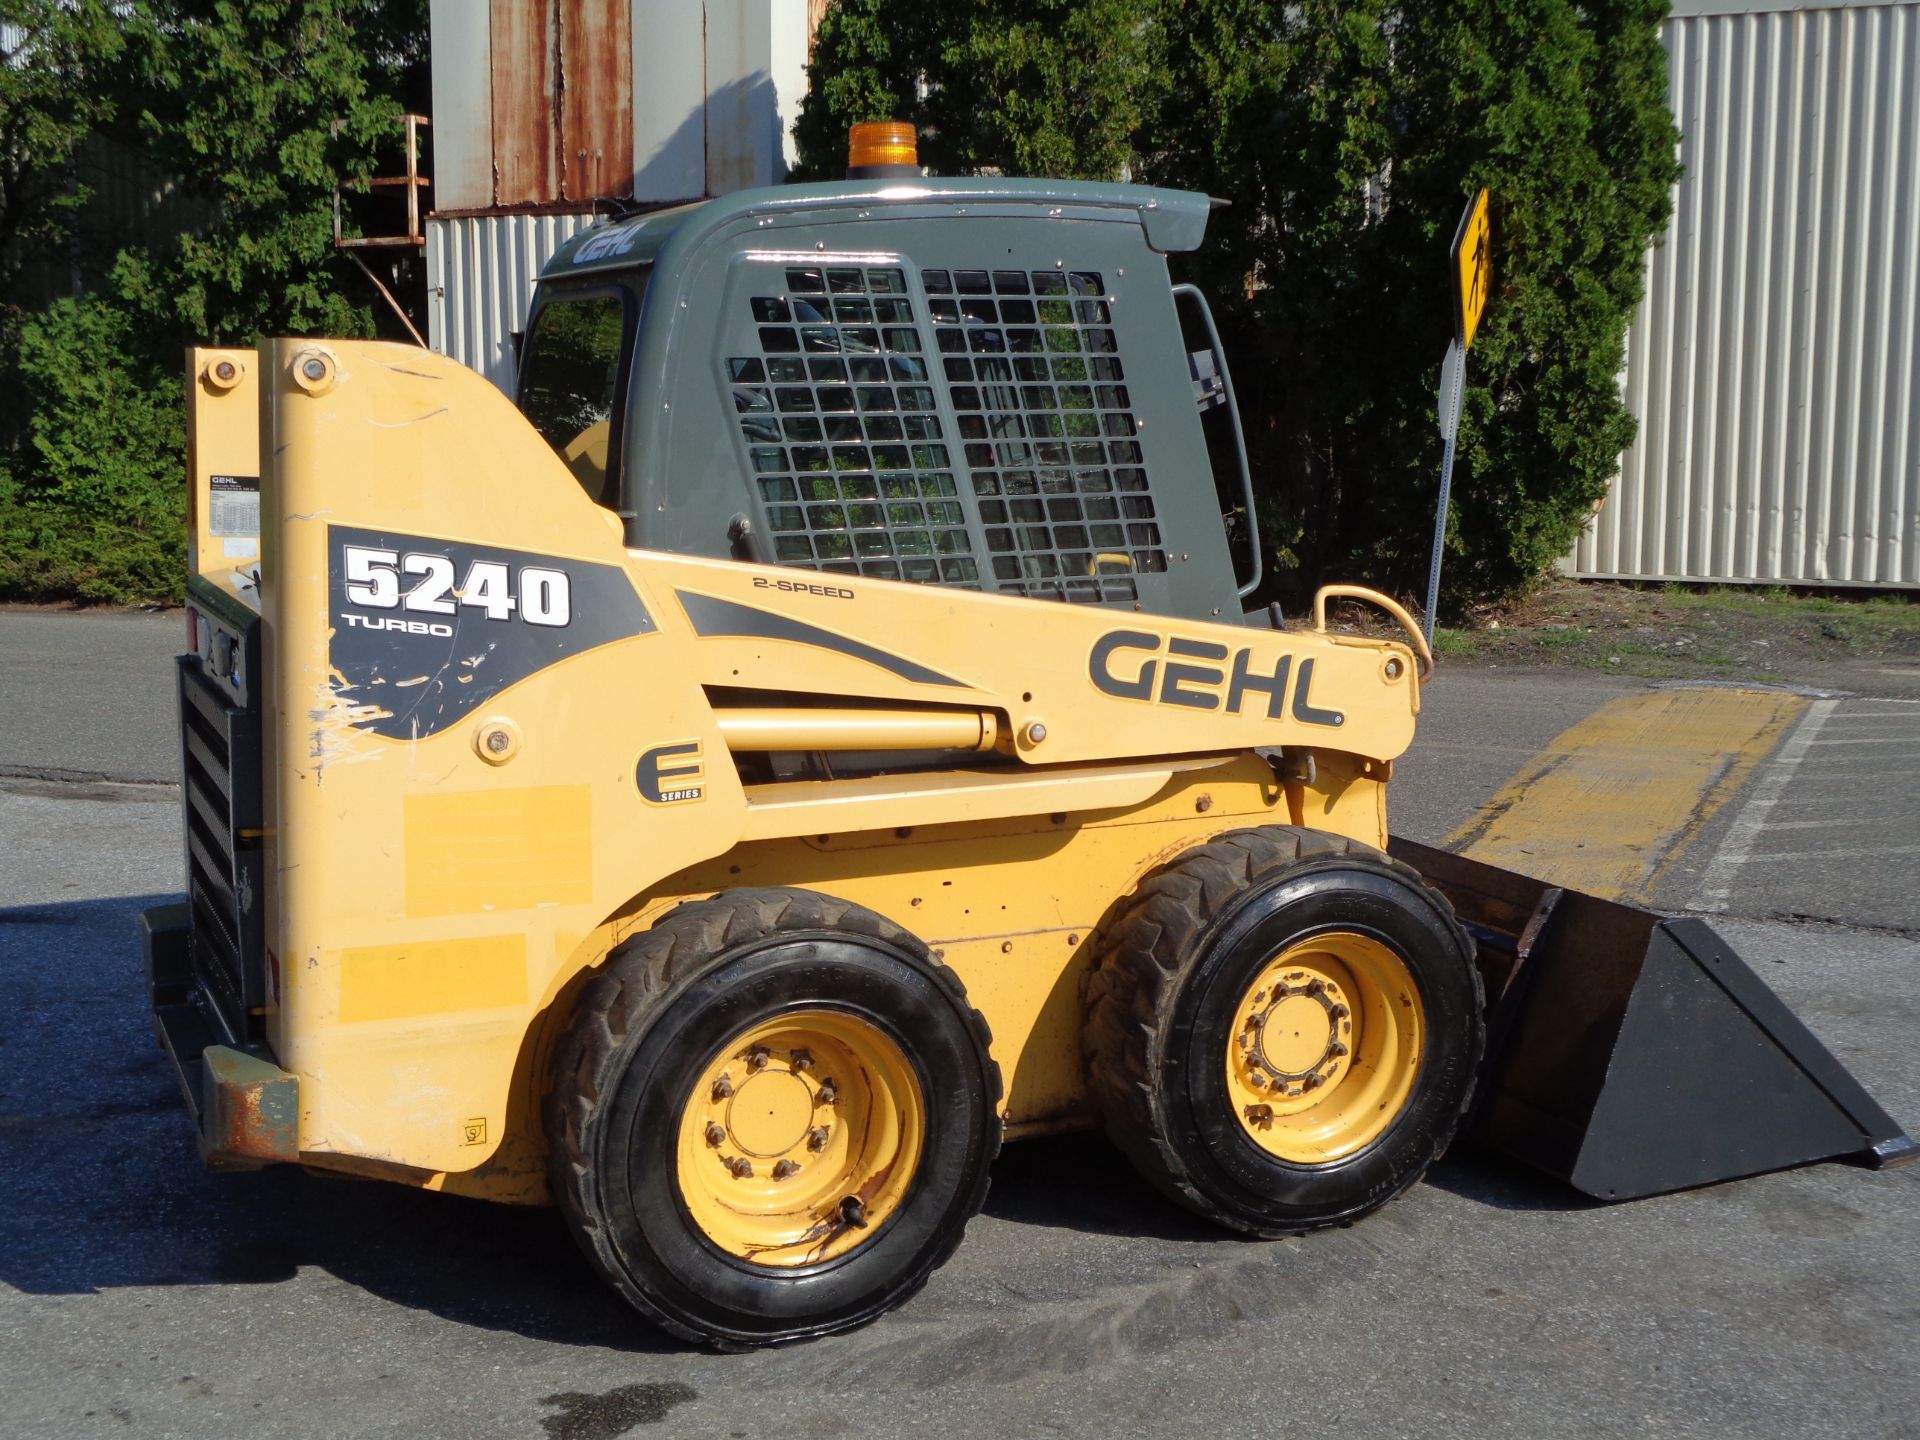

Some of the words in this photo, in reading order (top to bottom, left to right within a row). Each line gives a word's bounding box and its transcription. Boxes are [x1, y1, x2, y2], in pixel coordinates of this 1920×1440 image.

[211, 476, 238, 484] GEHL
[344, 545, 572, 629] 5240
[752, 577, 855, 600] 2-SPEED
[340, 613, 454, 638] TURBO
[1088, 629, 1345, 728] GEHL
[660, 788, 700, 802] SERIES
